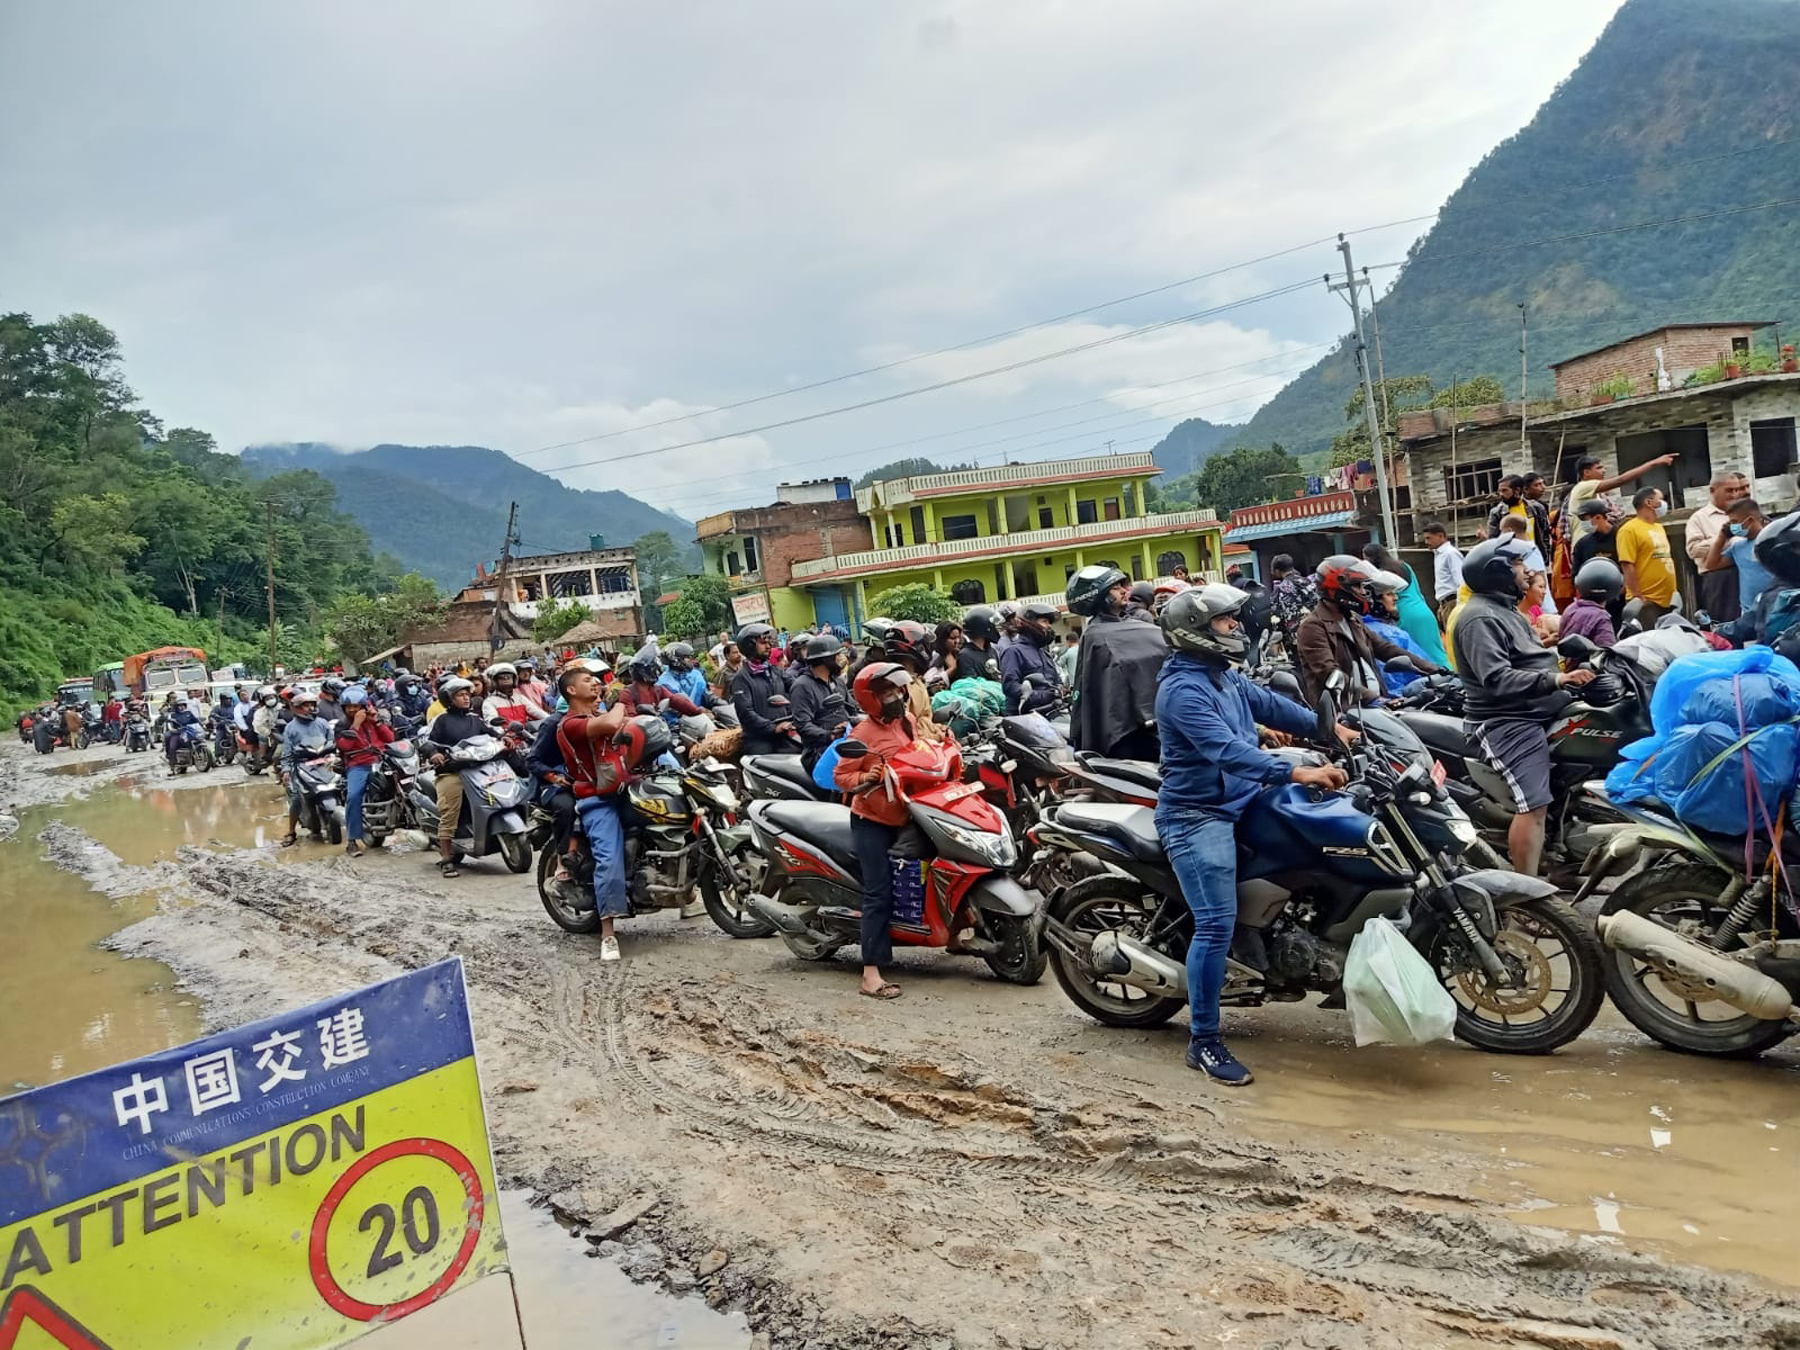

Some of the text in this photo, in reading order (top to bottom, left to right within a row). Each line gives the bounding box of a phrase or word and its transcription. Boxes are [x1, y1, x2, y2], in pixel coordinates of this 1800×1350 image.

[1452, 906, 1482, 944] YAMAHA
[112, 1007, 370, 1135] 中国交建
[122, 1140, 158, 1161] CHINA
[255, 1082, 327, 1116] CONSTRUCTION
[1, 1105, 366, 1291] ATTENTION
[358, 1186, 440, 1280] 20
